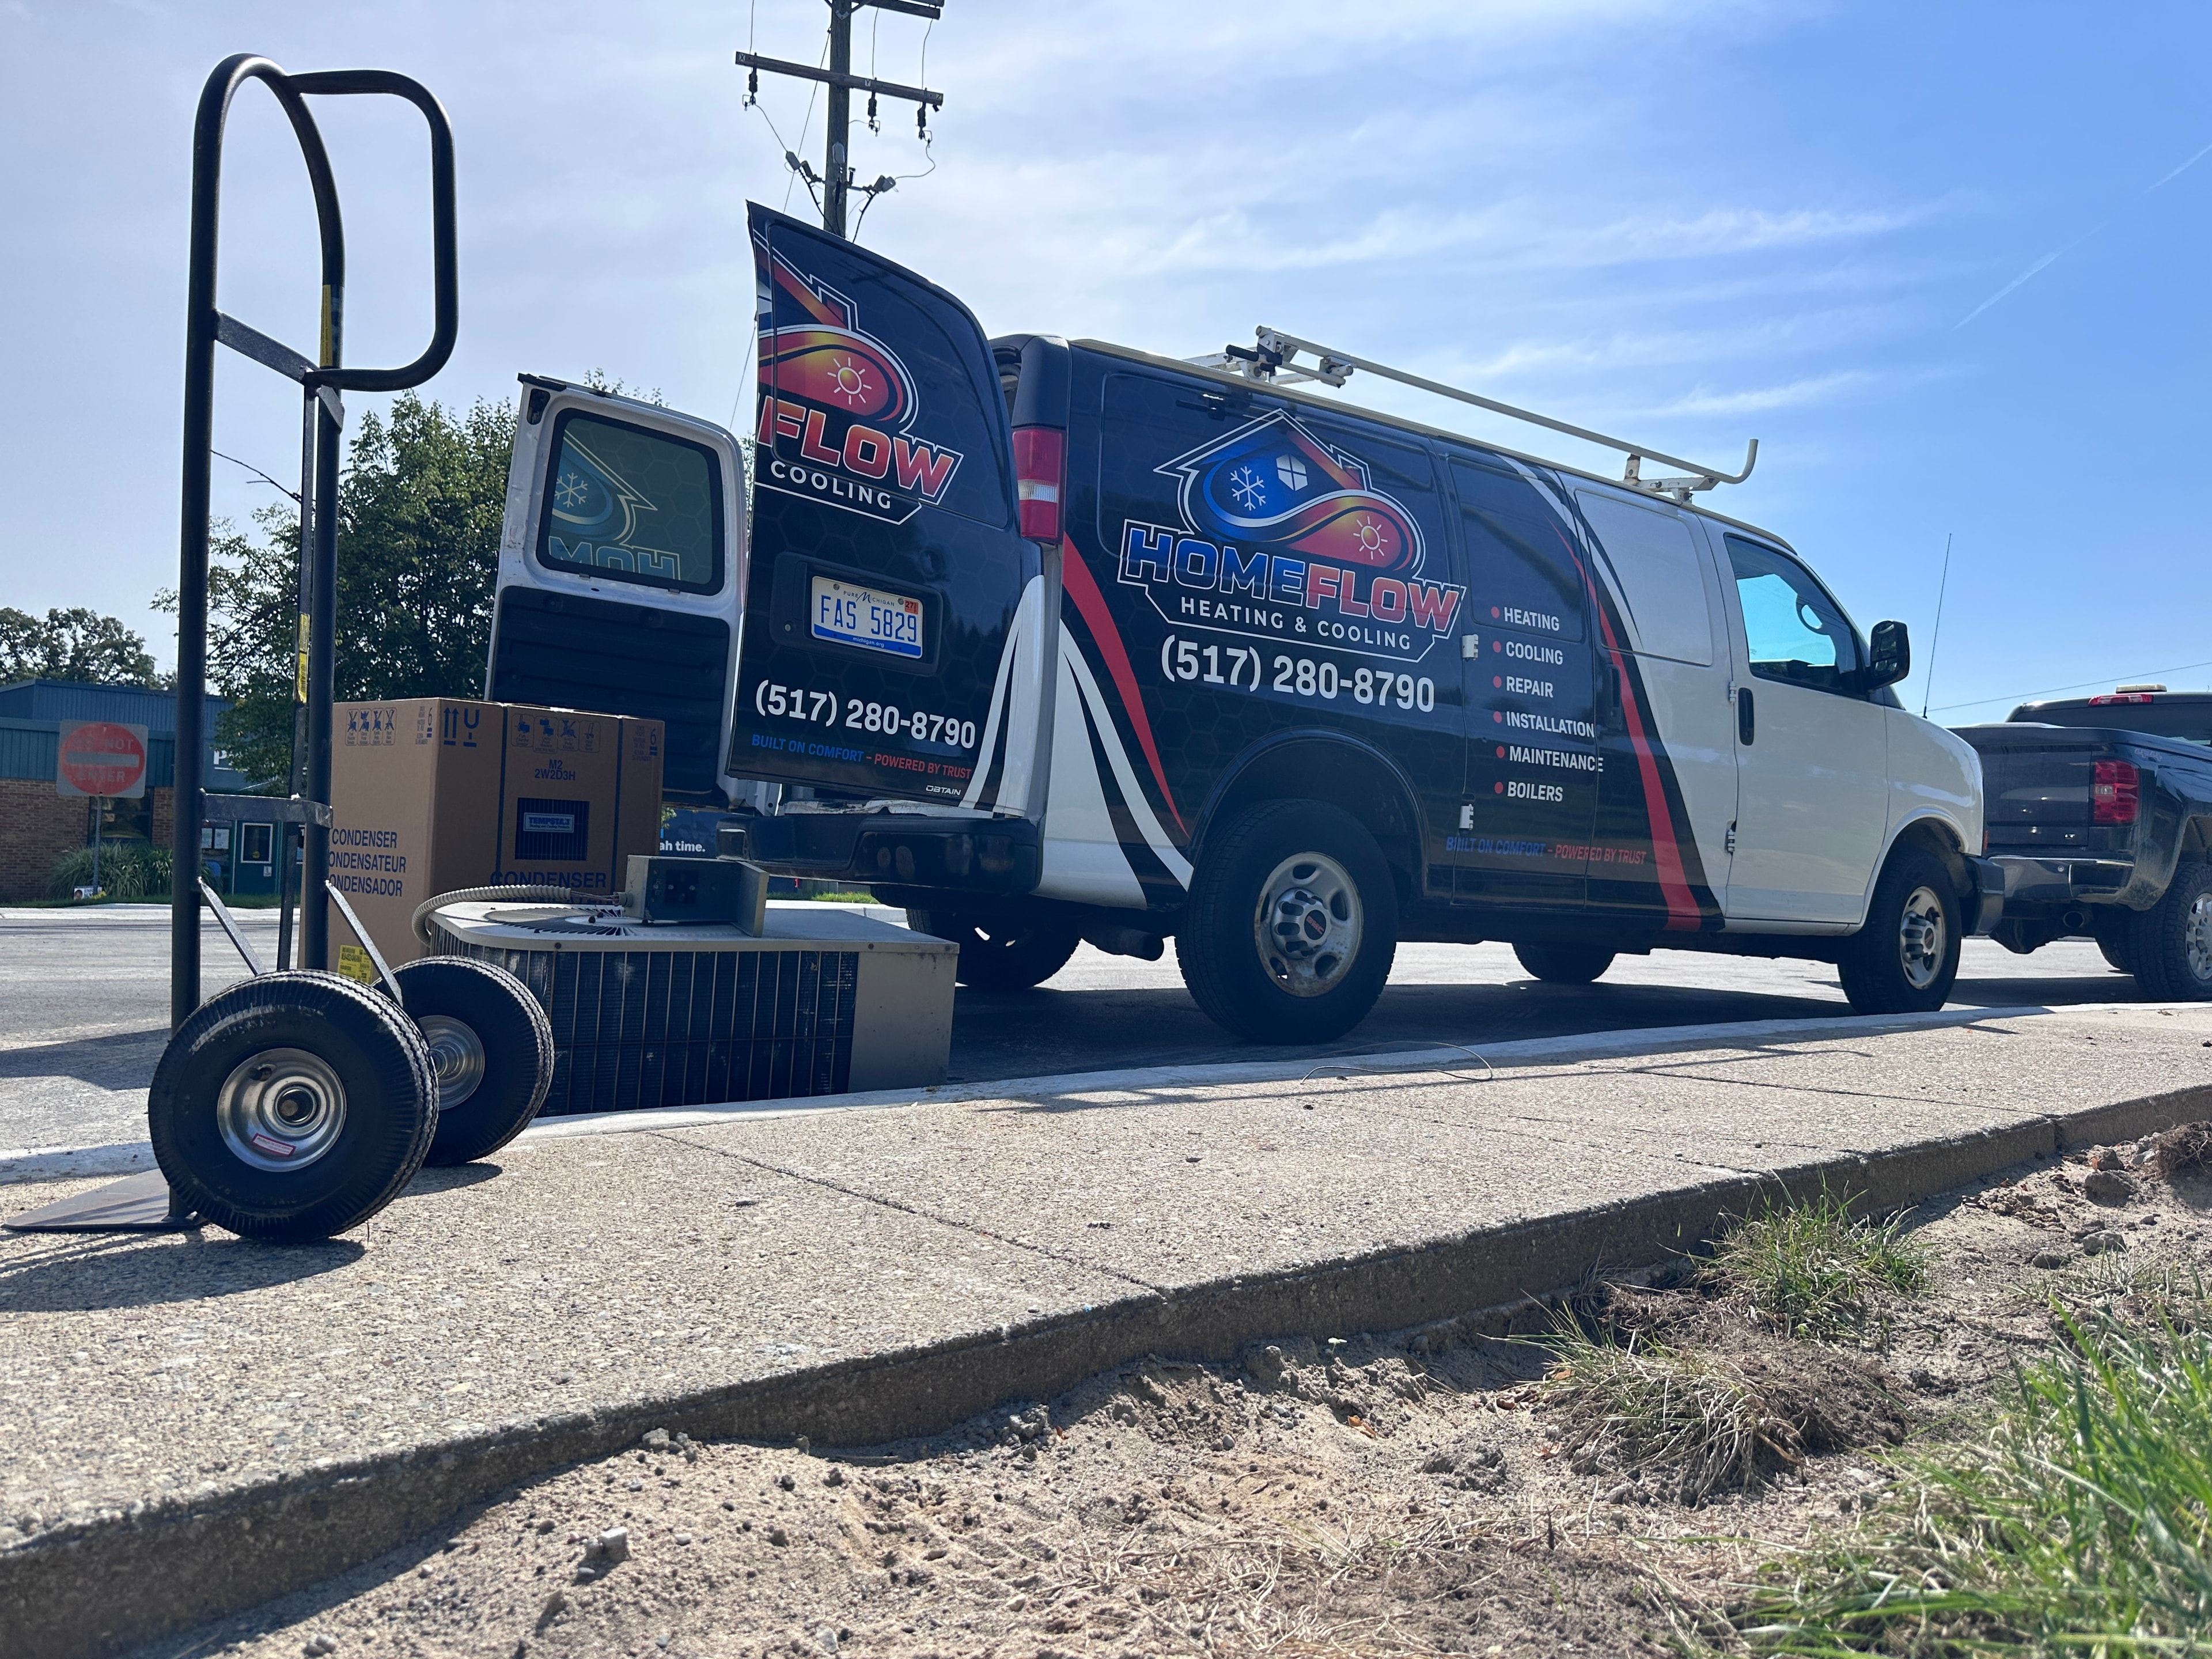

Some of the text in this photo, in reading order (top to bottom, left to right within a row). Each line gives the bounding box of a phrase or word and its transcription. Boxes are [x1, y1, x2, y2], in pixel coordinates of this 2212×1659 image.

[757, 396, 955, 497] FLOW
[771, 461, 891, 510] COOLING
[1125, 527, 1459, 631] HOMEFLOW
[843, 590, 895, 607] PURE MICHIGAN
[821, 594, 916, 643] FAS 5829
[1181, 597, 1410, 650] HEATING & COOLING
[1503, 607, 1560, 631] HEATING
[853, 637, 884, 648] michigan.org
[1506, 642, 1563, 665] COOLING
[1161, 634, 1435, 713] (517) 280-8790
[1506, 676, 1554, 698] REPAIR
[428, 707, 433, 726] 6
[755, 680, 976, 749] (517) 280-8790
[1506, 711, 1595, 738] INSTALLATION
[73, 737, 134, 751] DO NOT
[650, 728, 656, 745] 6
[549, 759, 563, 770] M2
[752, 734, 786, 750] BUILT
[789, 740, 805, 753] ON
[808, 743, 864, 763] COMFORT
[874, 753, 925, 772] POWERED
[927, 762, 941, 775] BY
[942, 764, 972, 779] TRUST
[1509, 746, 1604, 772] MAINTENANCE
[78, 767, 125, 782] ENTER
[535, 768, 575, 781] 2W2D3H
[926, 785, 961, 796] OBTAIN
[1508, 781, 1563, 802] BOILERS
[332, 828, 397, 849] CONDENSER
[675, 840, 706, 852] time.
[1445, 836, 1478, 853] BUILT
[1478, 838, 1495, 853] ON
[1496, 839, 1547, 857] COMFORT
[1554, 844, 1603, 862] POWERED
[1604, 847, 1618, 863] BY
[1618, 849, 1647, 865] TRUST
[329, 851, 406, 873] ONDENSATEUR
[329, 874, 403, 897] ONDENSADOR
[490, 871, 607, 888] CONDENSER
[1306, 915, 1324, 934] GMC
